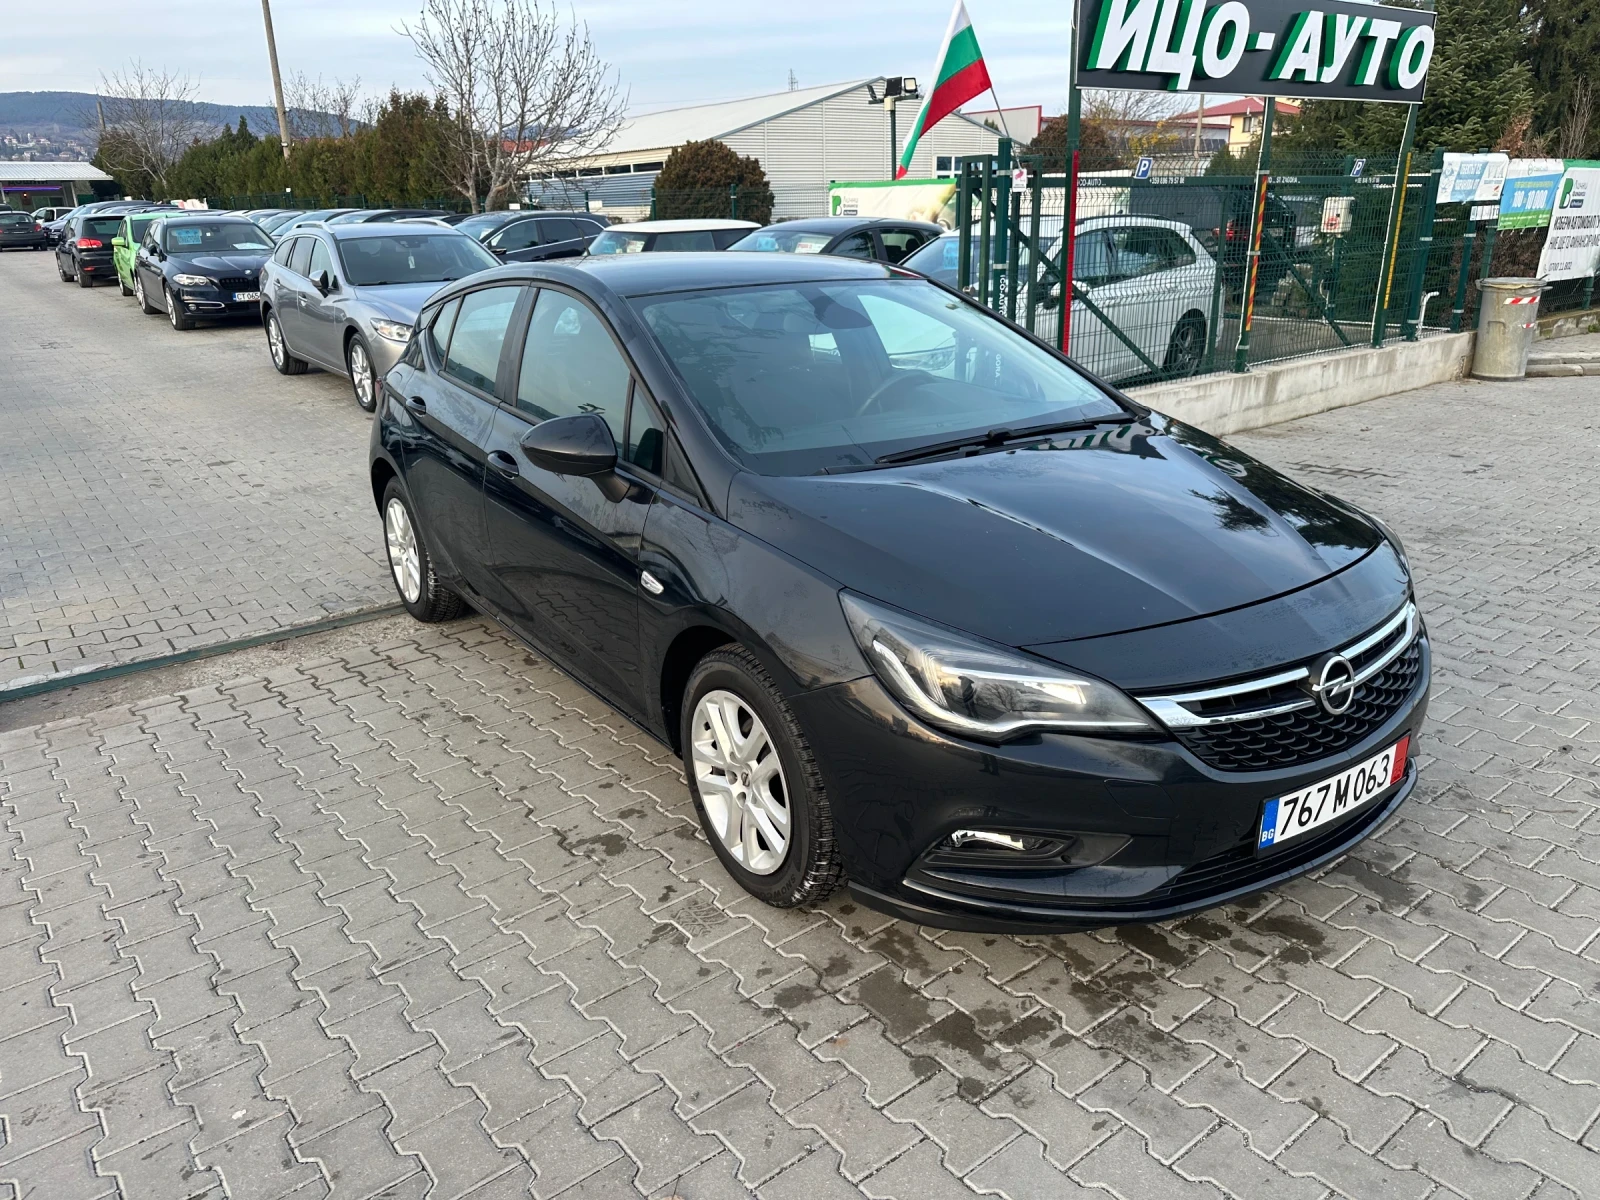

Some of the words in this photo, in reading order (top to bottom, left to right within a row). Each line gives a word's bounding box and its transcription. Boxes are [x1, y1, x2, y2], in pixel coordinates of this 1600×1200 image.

[1087, 0, 1434, 90] ИЦО-АУТО
[246, 292, 260, 300] 065
[1262, 828, 1275, 842] BG
